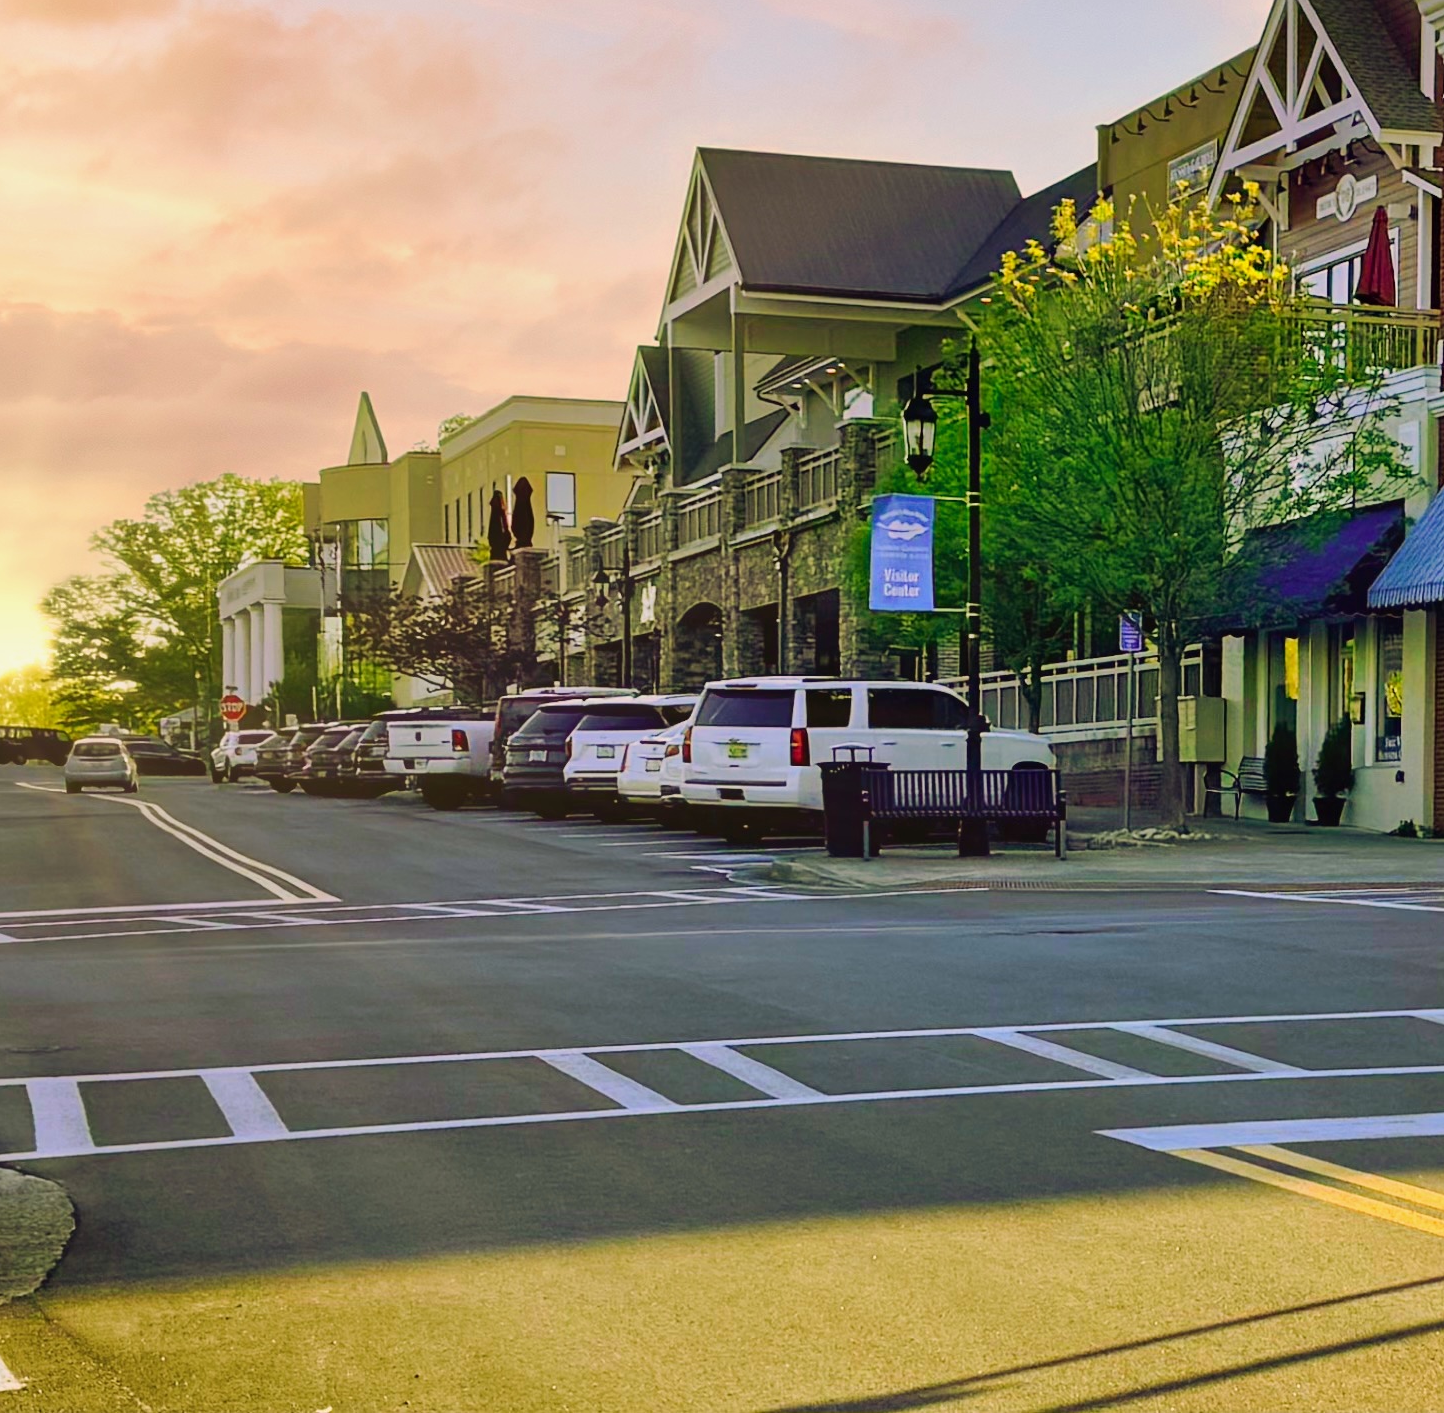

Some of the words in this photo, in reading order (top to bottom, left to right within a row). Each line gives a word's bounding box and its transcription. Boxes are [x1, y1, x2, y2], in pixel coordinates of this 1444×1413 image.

[883, 568, 919, 583] Visitor
[883, 583, 920, 597] Center
[221, 701, 243, 712] STOP
